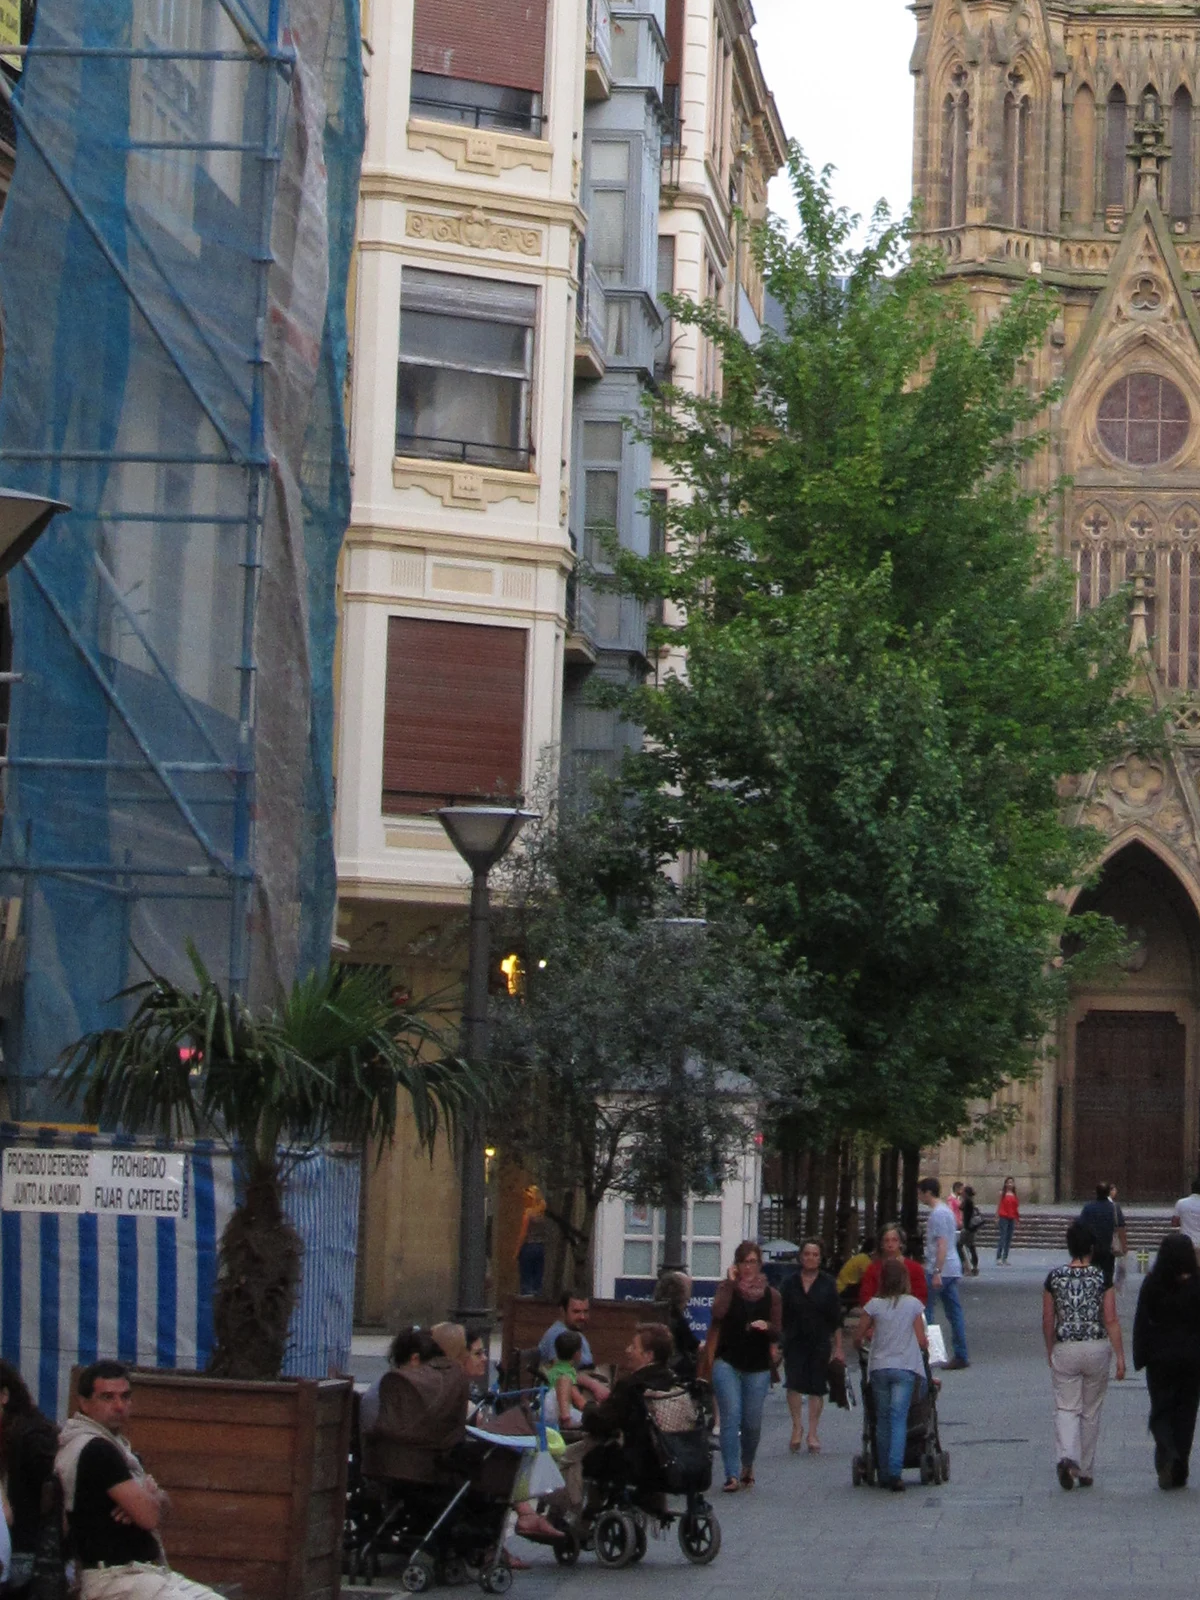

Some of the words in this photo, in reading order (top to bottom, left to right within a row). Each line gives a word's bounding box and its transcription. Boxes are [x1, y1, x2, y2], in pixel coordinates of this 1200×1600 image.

[8, 1153, 46, 1175] PROHIBIDO
[47, 1154, 90, 1177] DETENERSE
[111, 1155, 167, 1179] PROHIBIDO
[14, 1182, 37, 1205] JUNTO
[38, 1183, 47, 1205] AL
[94, 1187, 123, 1210] FIJAR
[127, 1188, 180, 1212] CARTELES
